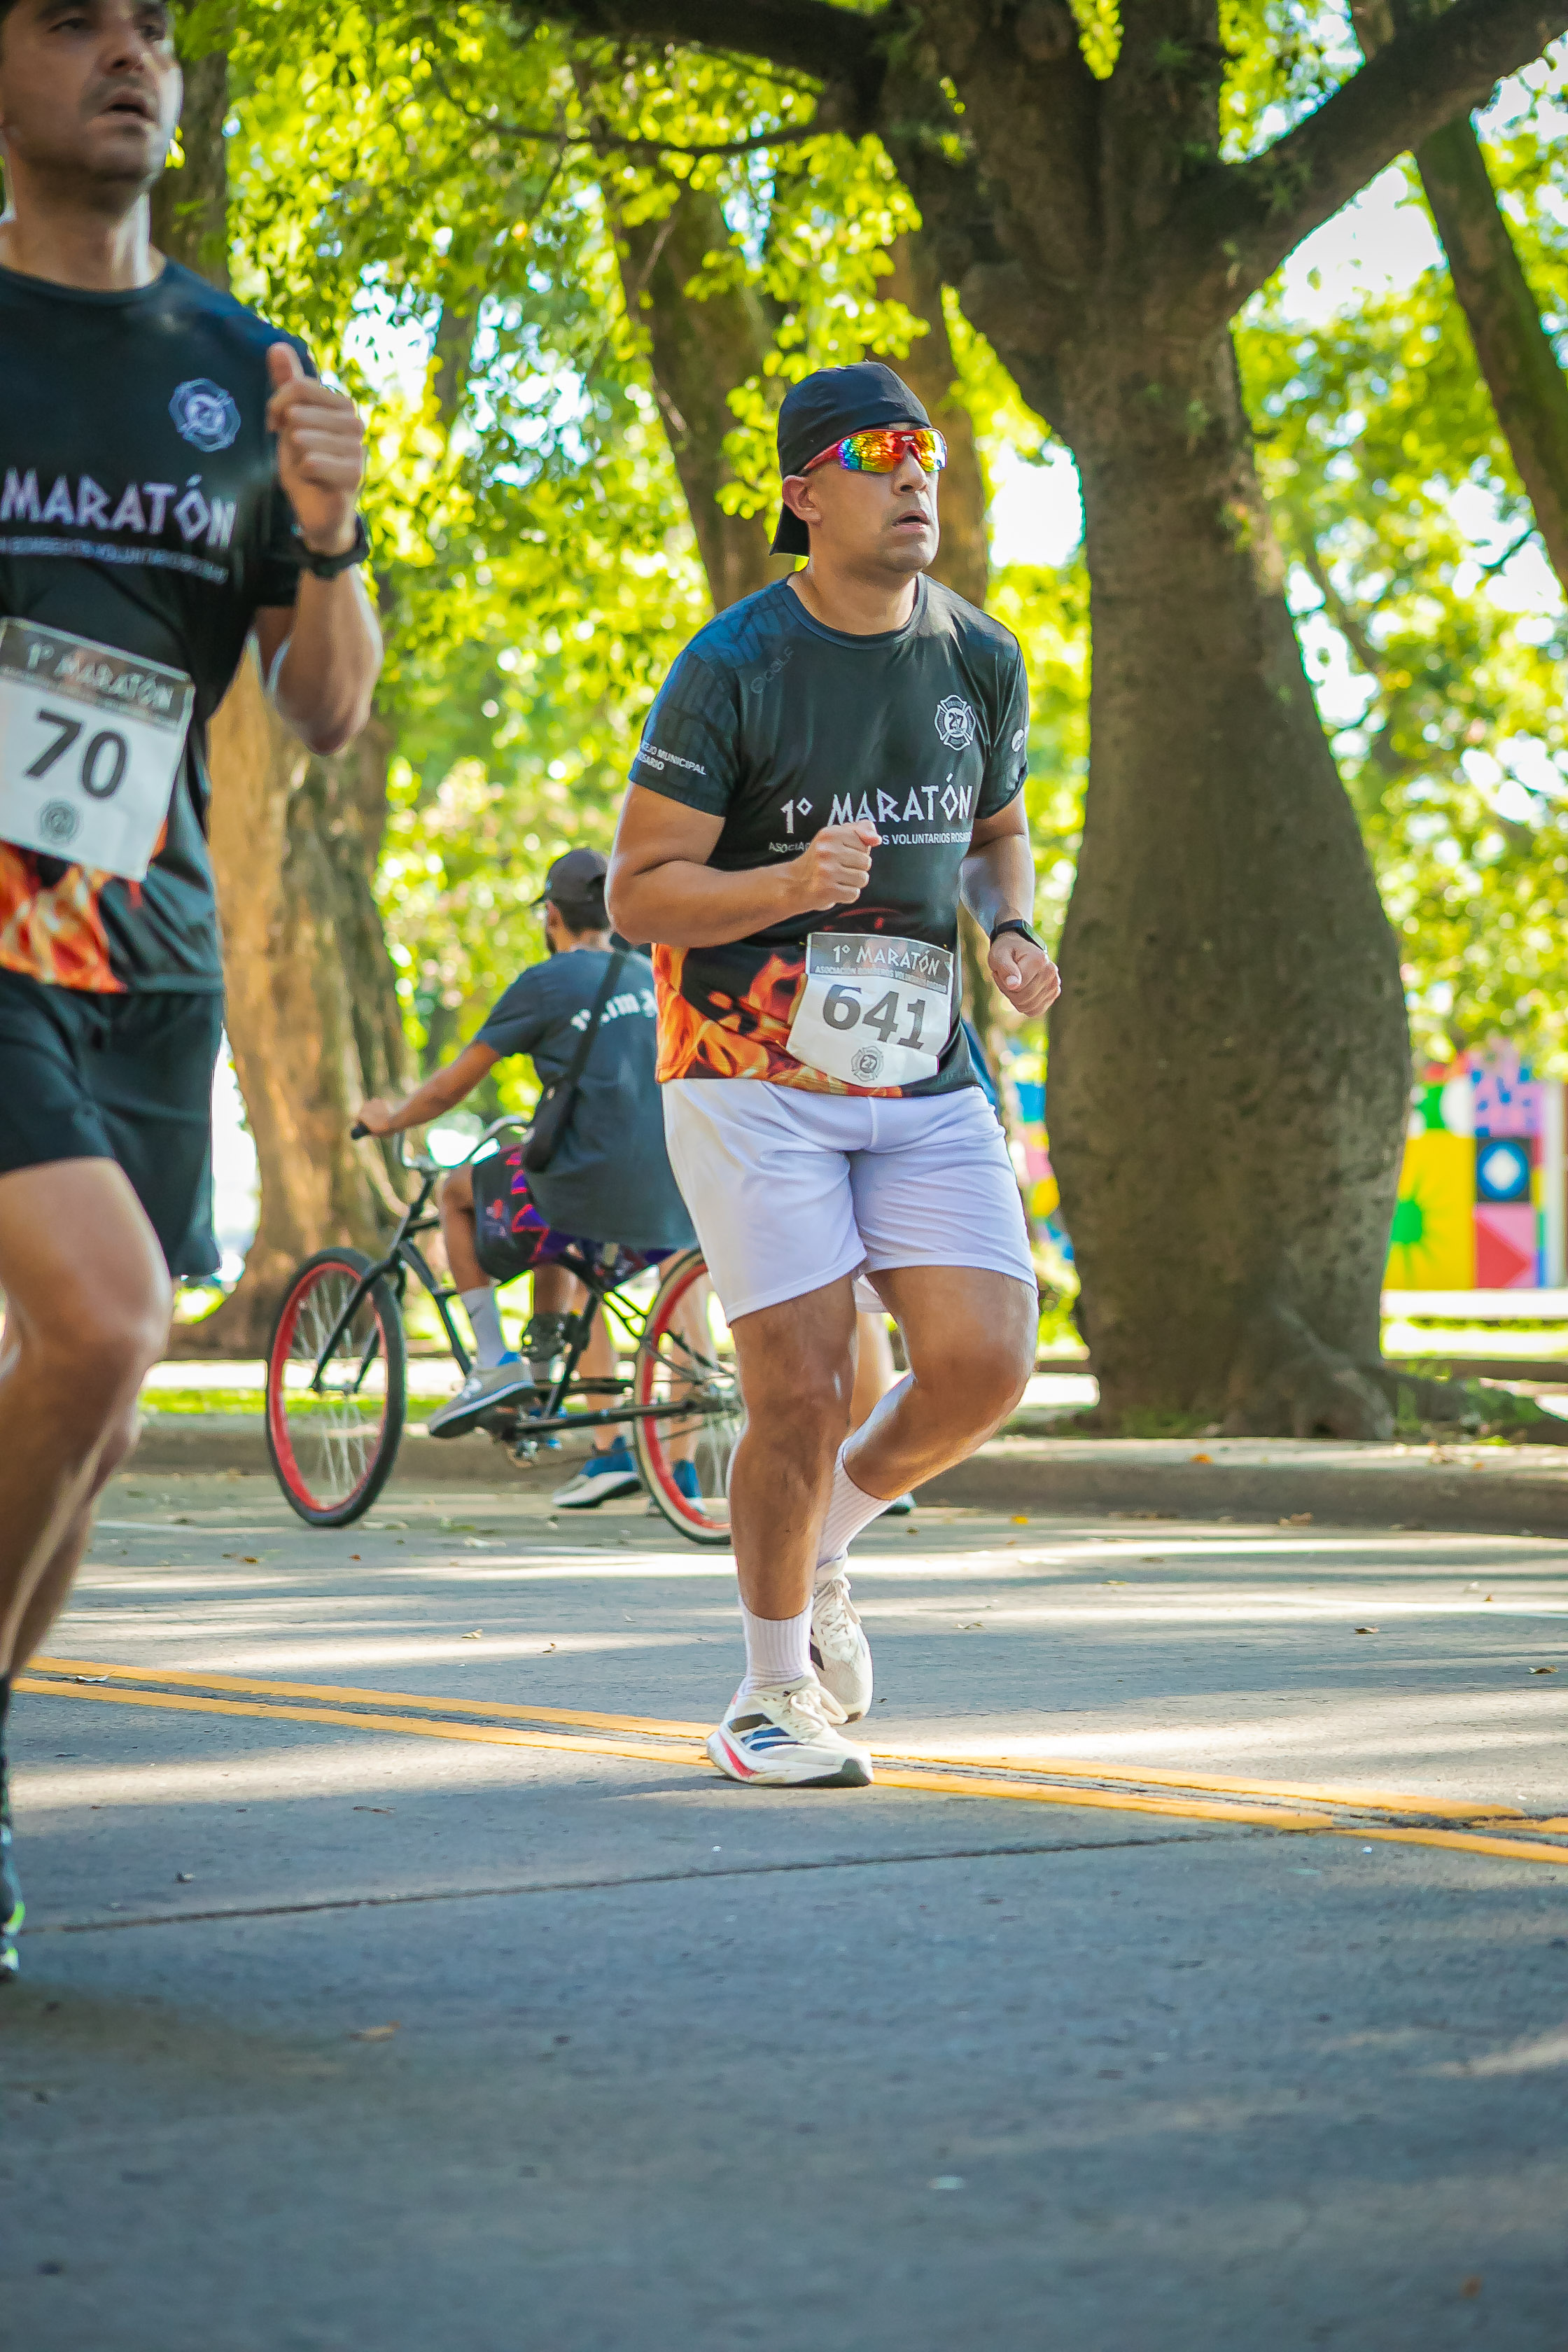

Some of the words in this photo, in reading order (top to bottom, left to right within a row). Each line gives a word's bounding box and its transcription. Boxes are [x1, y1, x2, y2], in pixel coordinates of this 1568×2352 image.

[1, 466, 237, 549] MARATÓN
[24, 708, 127, 799] 70
[657, 748, 707, 776] MUNICIPAL
[827, 772, 973, 827] MARATÓN
[891, 832, 951, 845] VOLUNTARIOS
[856, 945, 940, 976] MARATÓN
[823, 984, 925, 1050] 641
